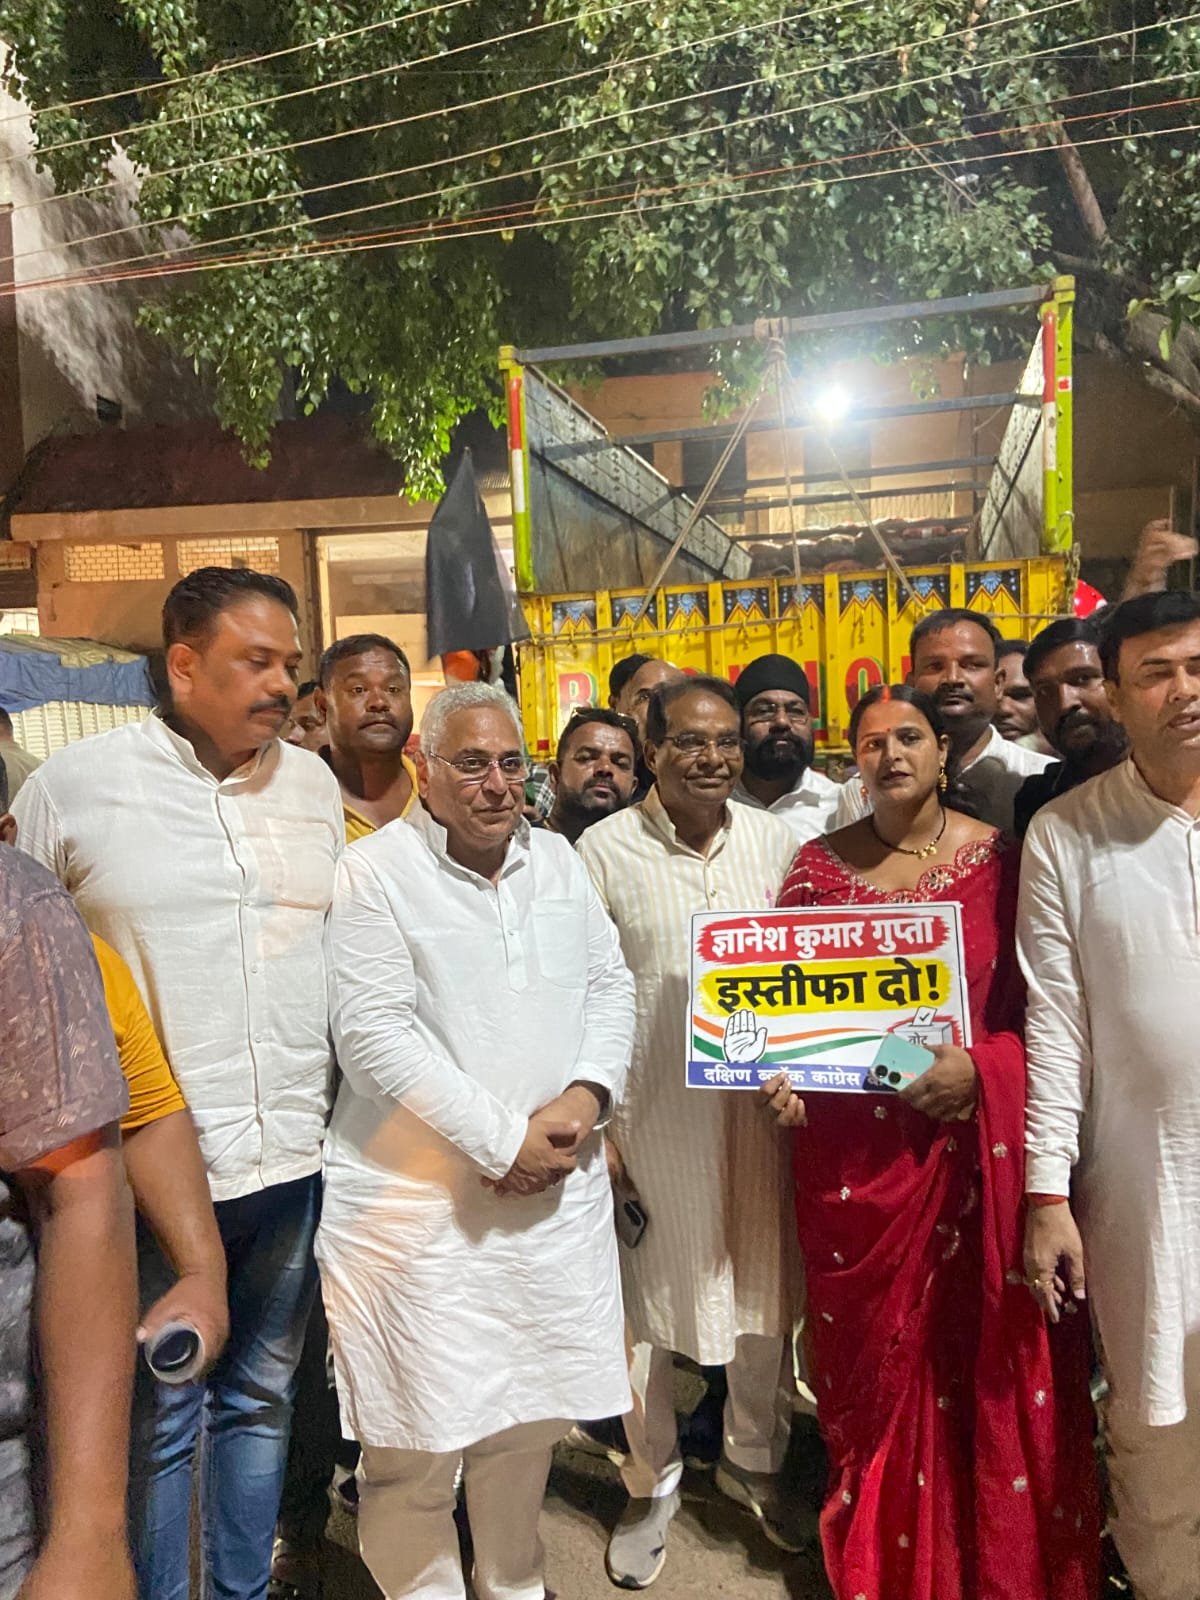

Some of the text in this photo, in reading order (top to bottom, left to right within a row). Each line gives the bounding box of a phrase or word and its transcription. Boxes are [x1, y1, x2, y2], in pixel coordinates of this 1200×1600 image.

[711, 916, 934, 959] ज्ञानेश कुमार गुप्ता
[716, 958, 940, 1012] इस्तीफा दो!
[704, 1064, 751, 1084] दक्षिण
[812, 1066, 861, 1086] कांग्रेस
